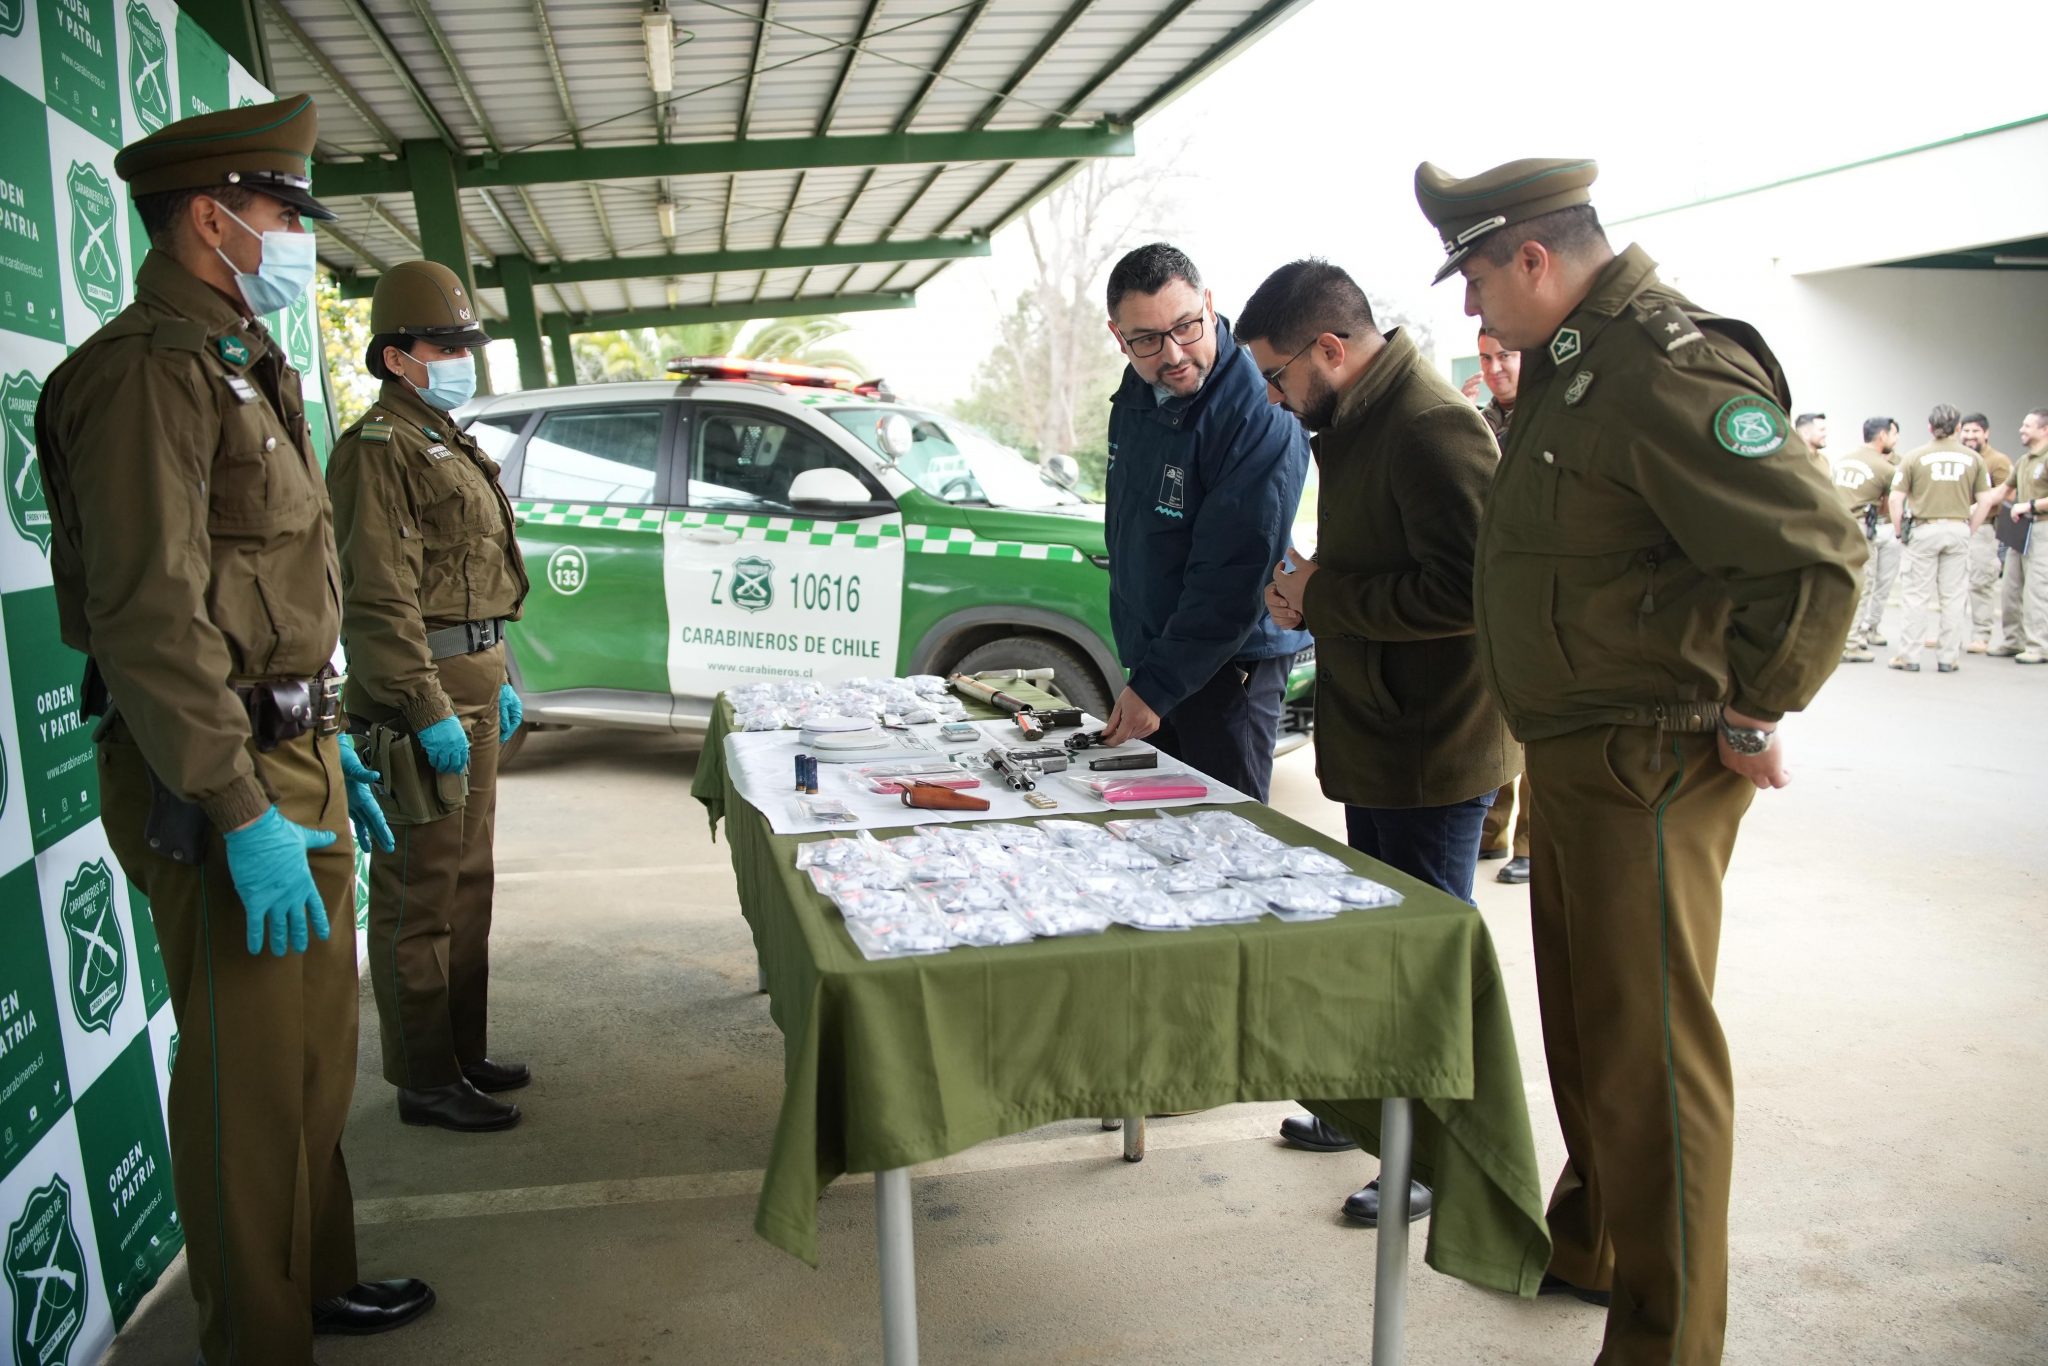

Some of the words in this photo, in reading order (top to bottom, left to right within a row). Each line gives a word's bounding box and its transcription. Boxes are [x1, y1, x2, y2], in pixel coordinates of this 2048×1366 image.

[56, 7, 63, 27] Y
[66, 15, 103, 57] PATRIA
[0, 179, 24, 208] DEN
[555, 569, 579, 586] 133
[711, 569, 723, 605] Z
[789, 572, 861, 613] 10616
[681, 626, 798, 652] CARABINEROS
[804, 635, 826, 654] DE
[832, 637, 881, 658] CHILE
[706, 662, 813, 679] www.carabineros.cl
[37, 684, 74, 714] ORDEN
[40, 722, 47, 743] Y
[50, 709, 88, 739] PATRI
[46, 747, 93, 780] www.carabineros.cl
[69, 882, 100, 914] CARABINEROS
[99, 877, 106, 892] DE
[83, 899, 96, 919] CHILE
[109, 1141, 143, 1192] ORDEN
[112, 1197, 119, 1218] Y
[121, 1155, 155, 1208] PATRIA
[14, 1205, 54, 1260] CARABINEROS
[53, 1195, 62, 1213] DE
[120, 1188, 163, 1252] www.carabineros.cl
[33, 1227, 50, 1256] CHILE
